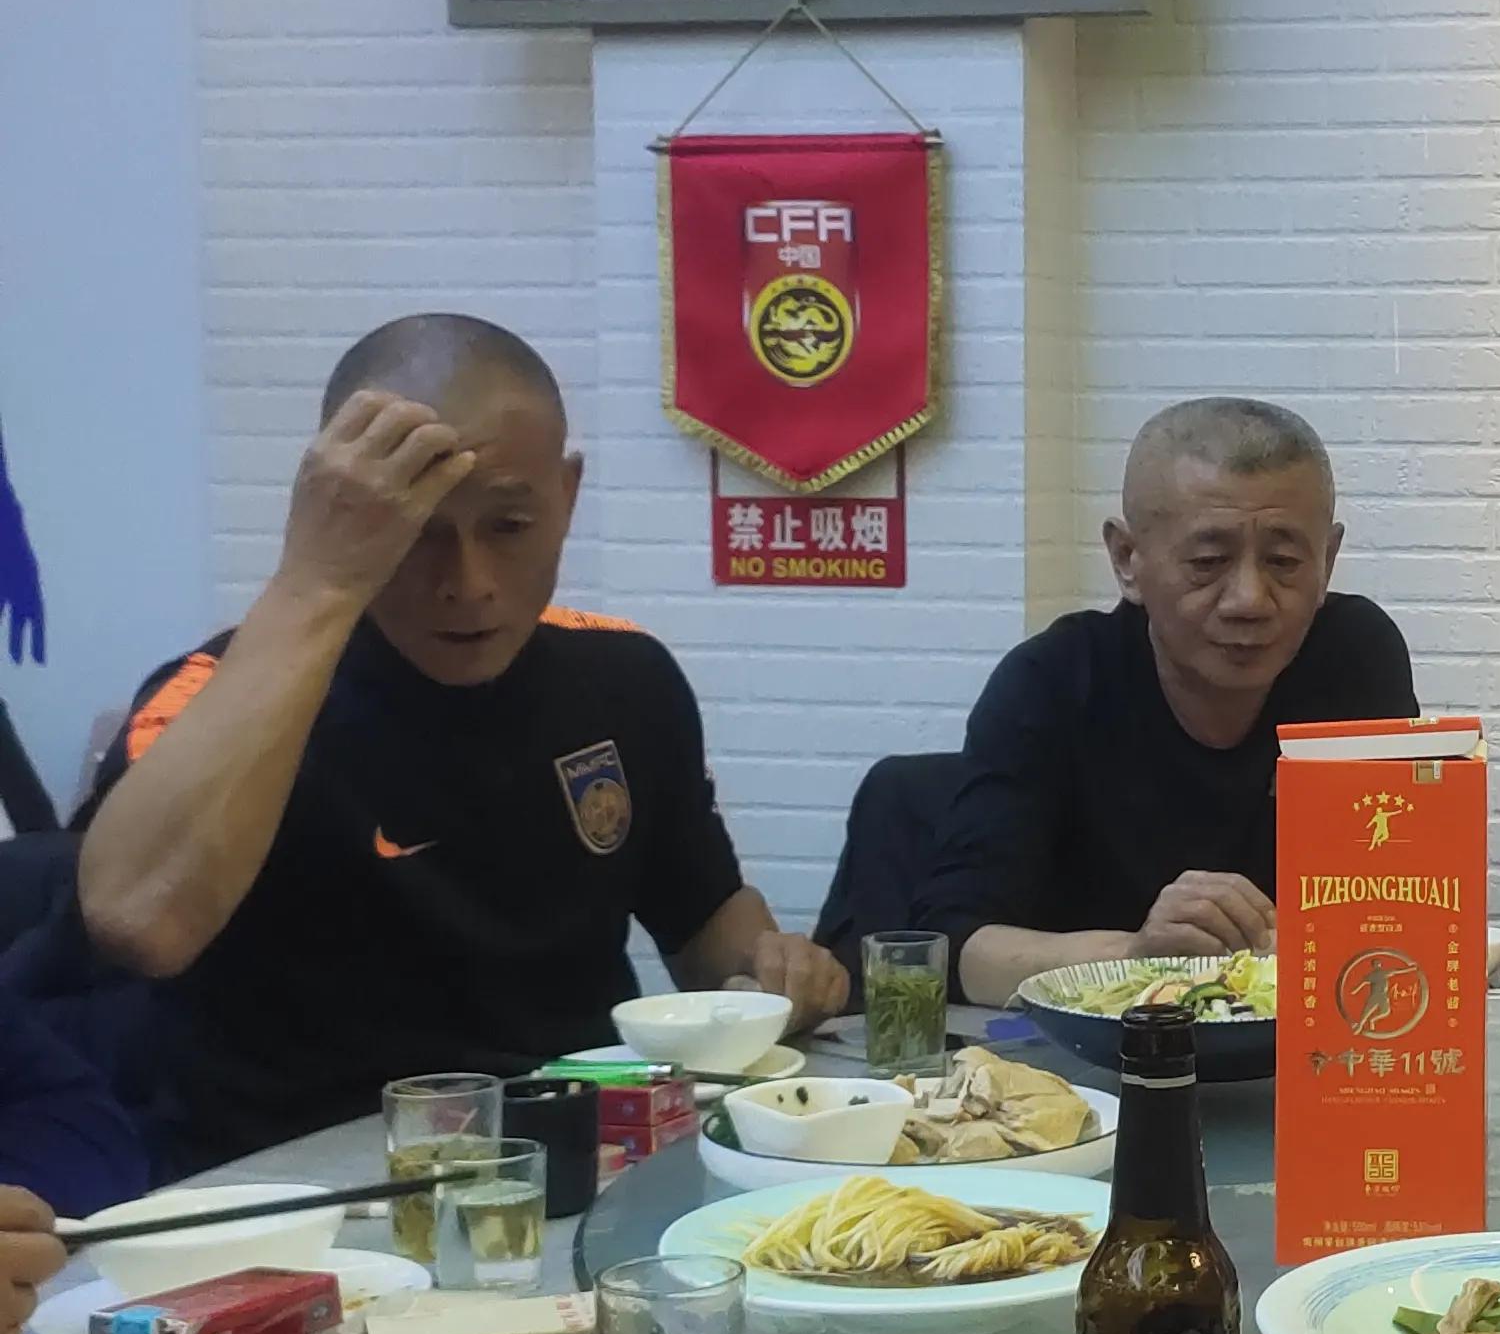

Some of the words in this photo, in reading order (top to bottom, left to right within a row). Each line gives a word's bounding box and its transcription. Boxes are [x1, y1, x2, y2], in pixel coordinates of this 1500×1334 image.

[745, 208, 852, 242] CFA
[777, 242, 821, 268] 中国
[728, 503, 888, 552] 禁止吸烟
[730, 556, 766, 578] NO
[772, 557, 887, 579] SMOKING
[1300, 875, 1461, 913] LIZHONGHUA11
